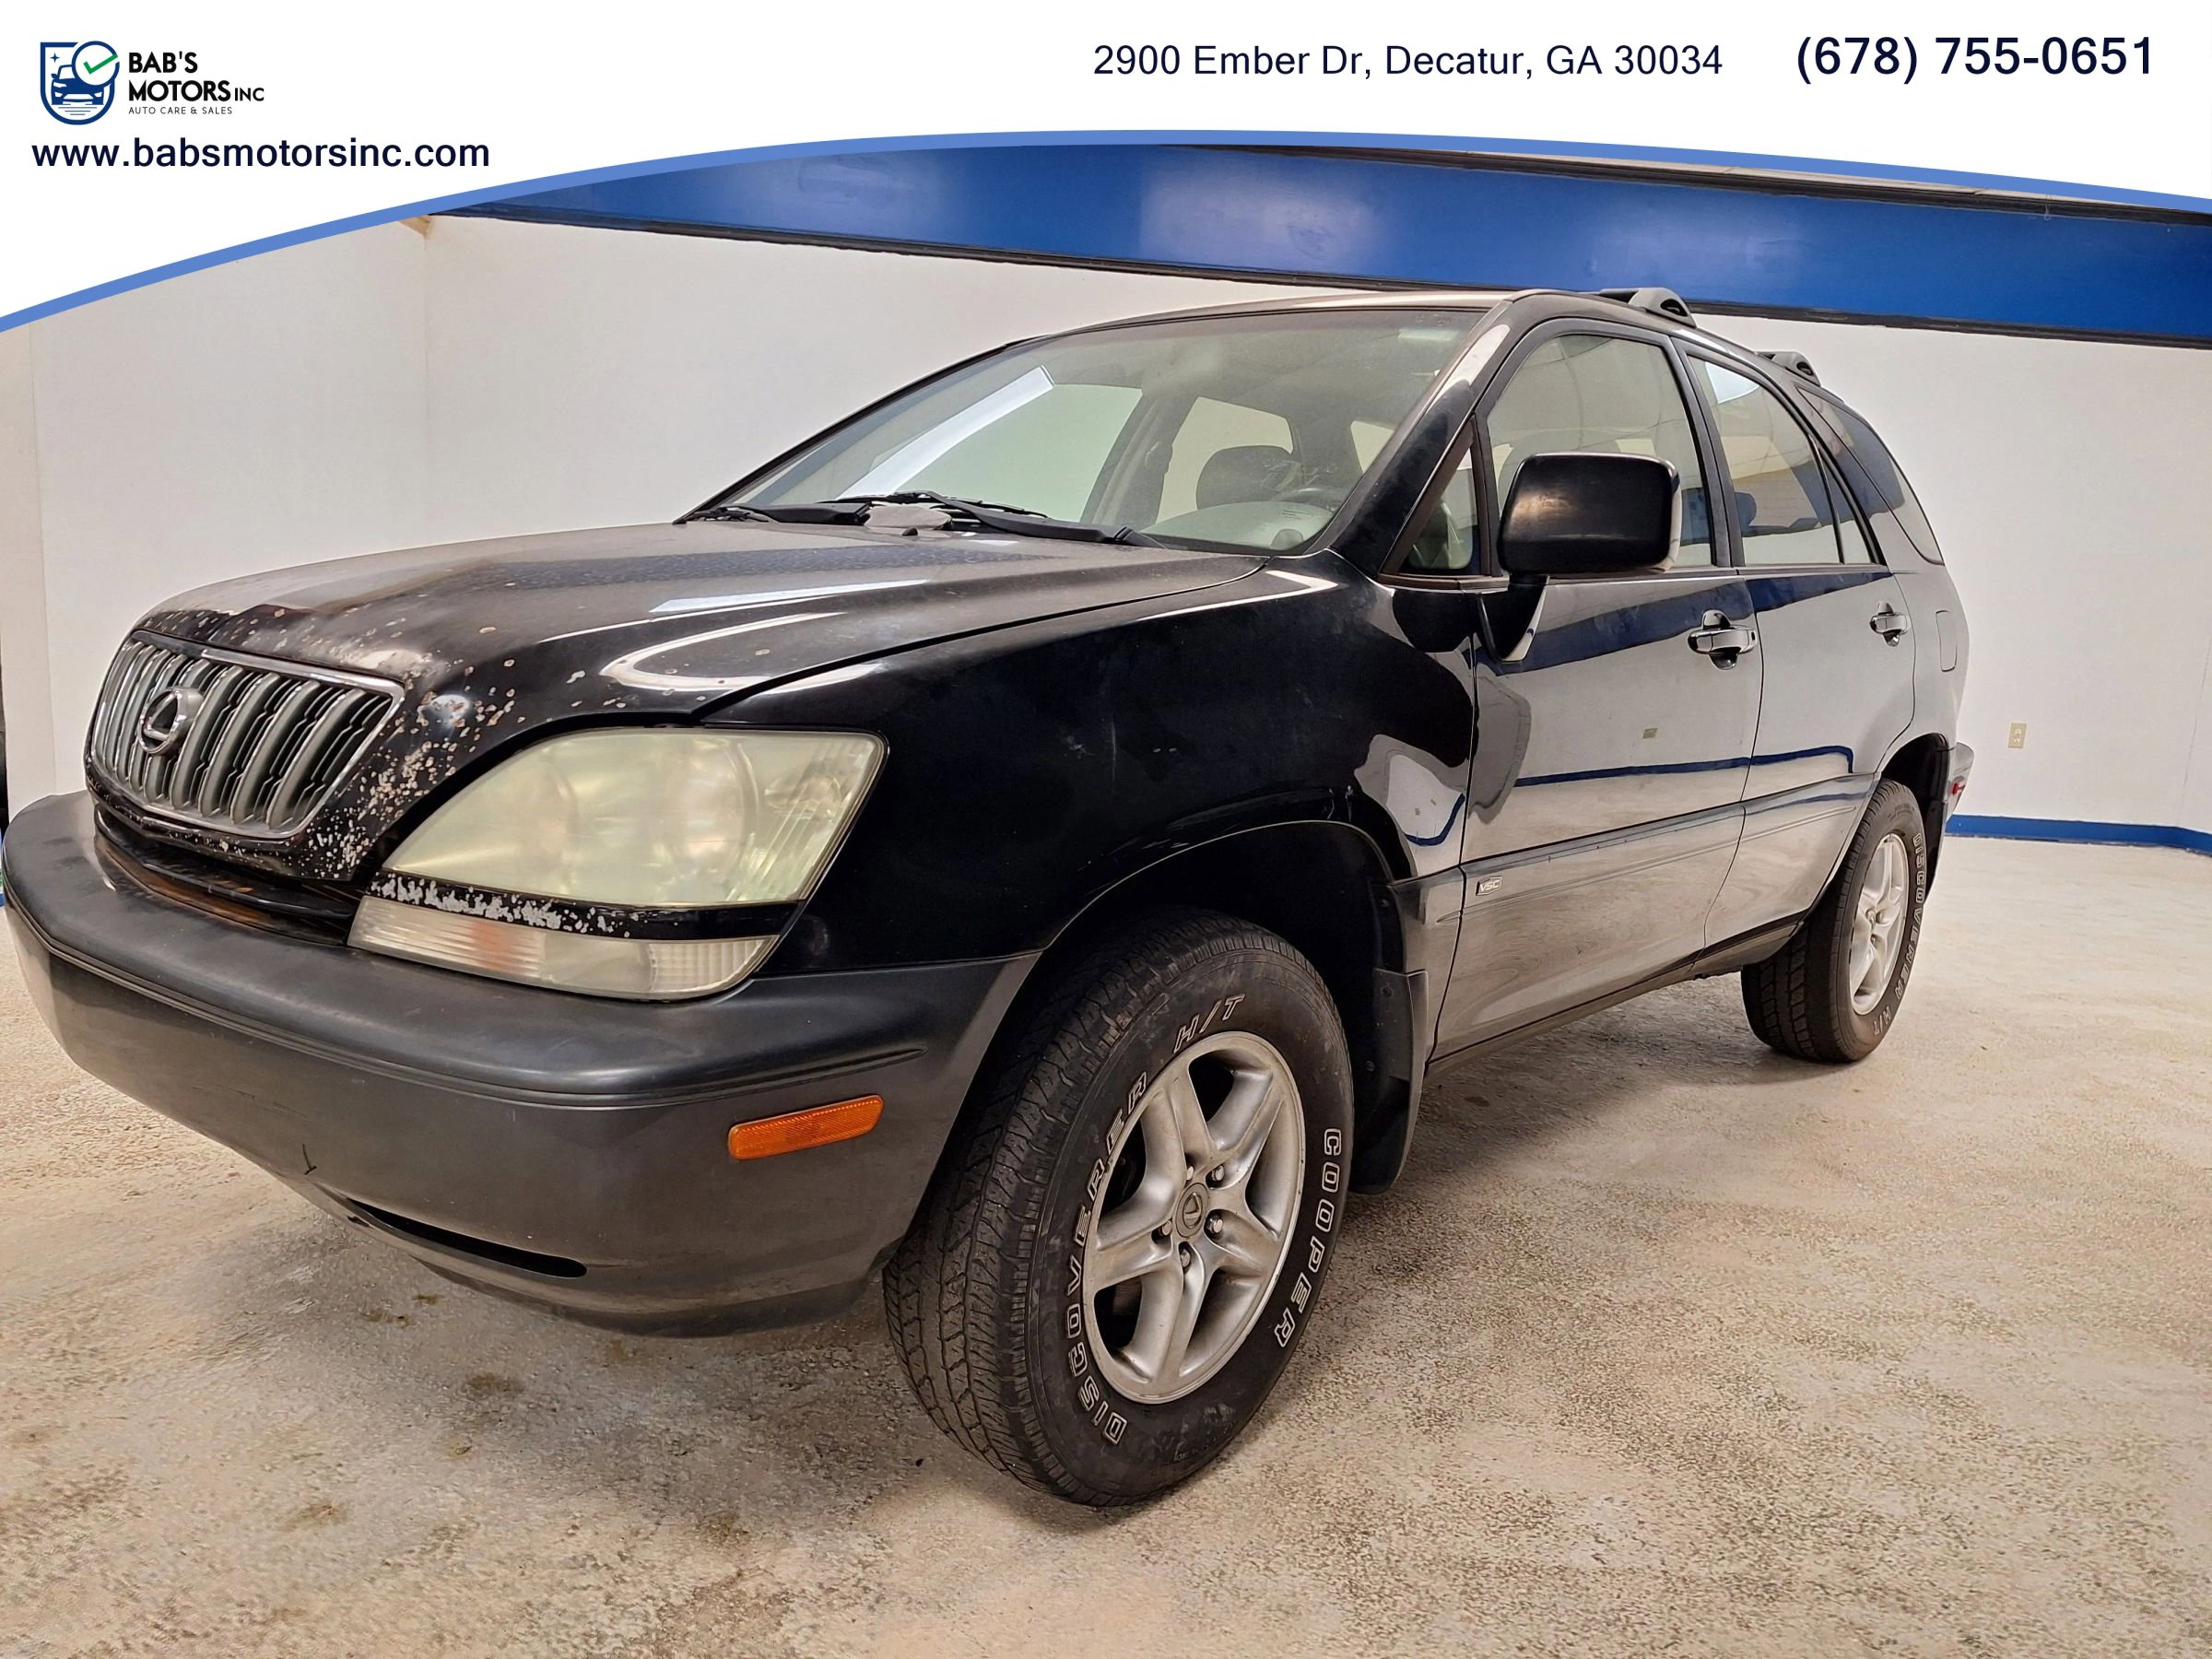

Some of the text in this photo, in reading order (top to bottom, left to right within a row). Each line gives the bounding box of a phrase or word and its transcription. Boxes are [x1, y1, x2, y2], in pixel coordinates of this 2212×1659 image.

[1478, 878, 1500, 892] VSC
[1895, 832, 1925, 1000] DISCOVERER
[1066, 993, 1246, 1446] DISCOVERER H/T
[1278, 1128, 1343, 1348] COOPER
